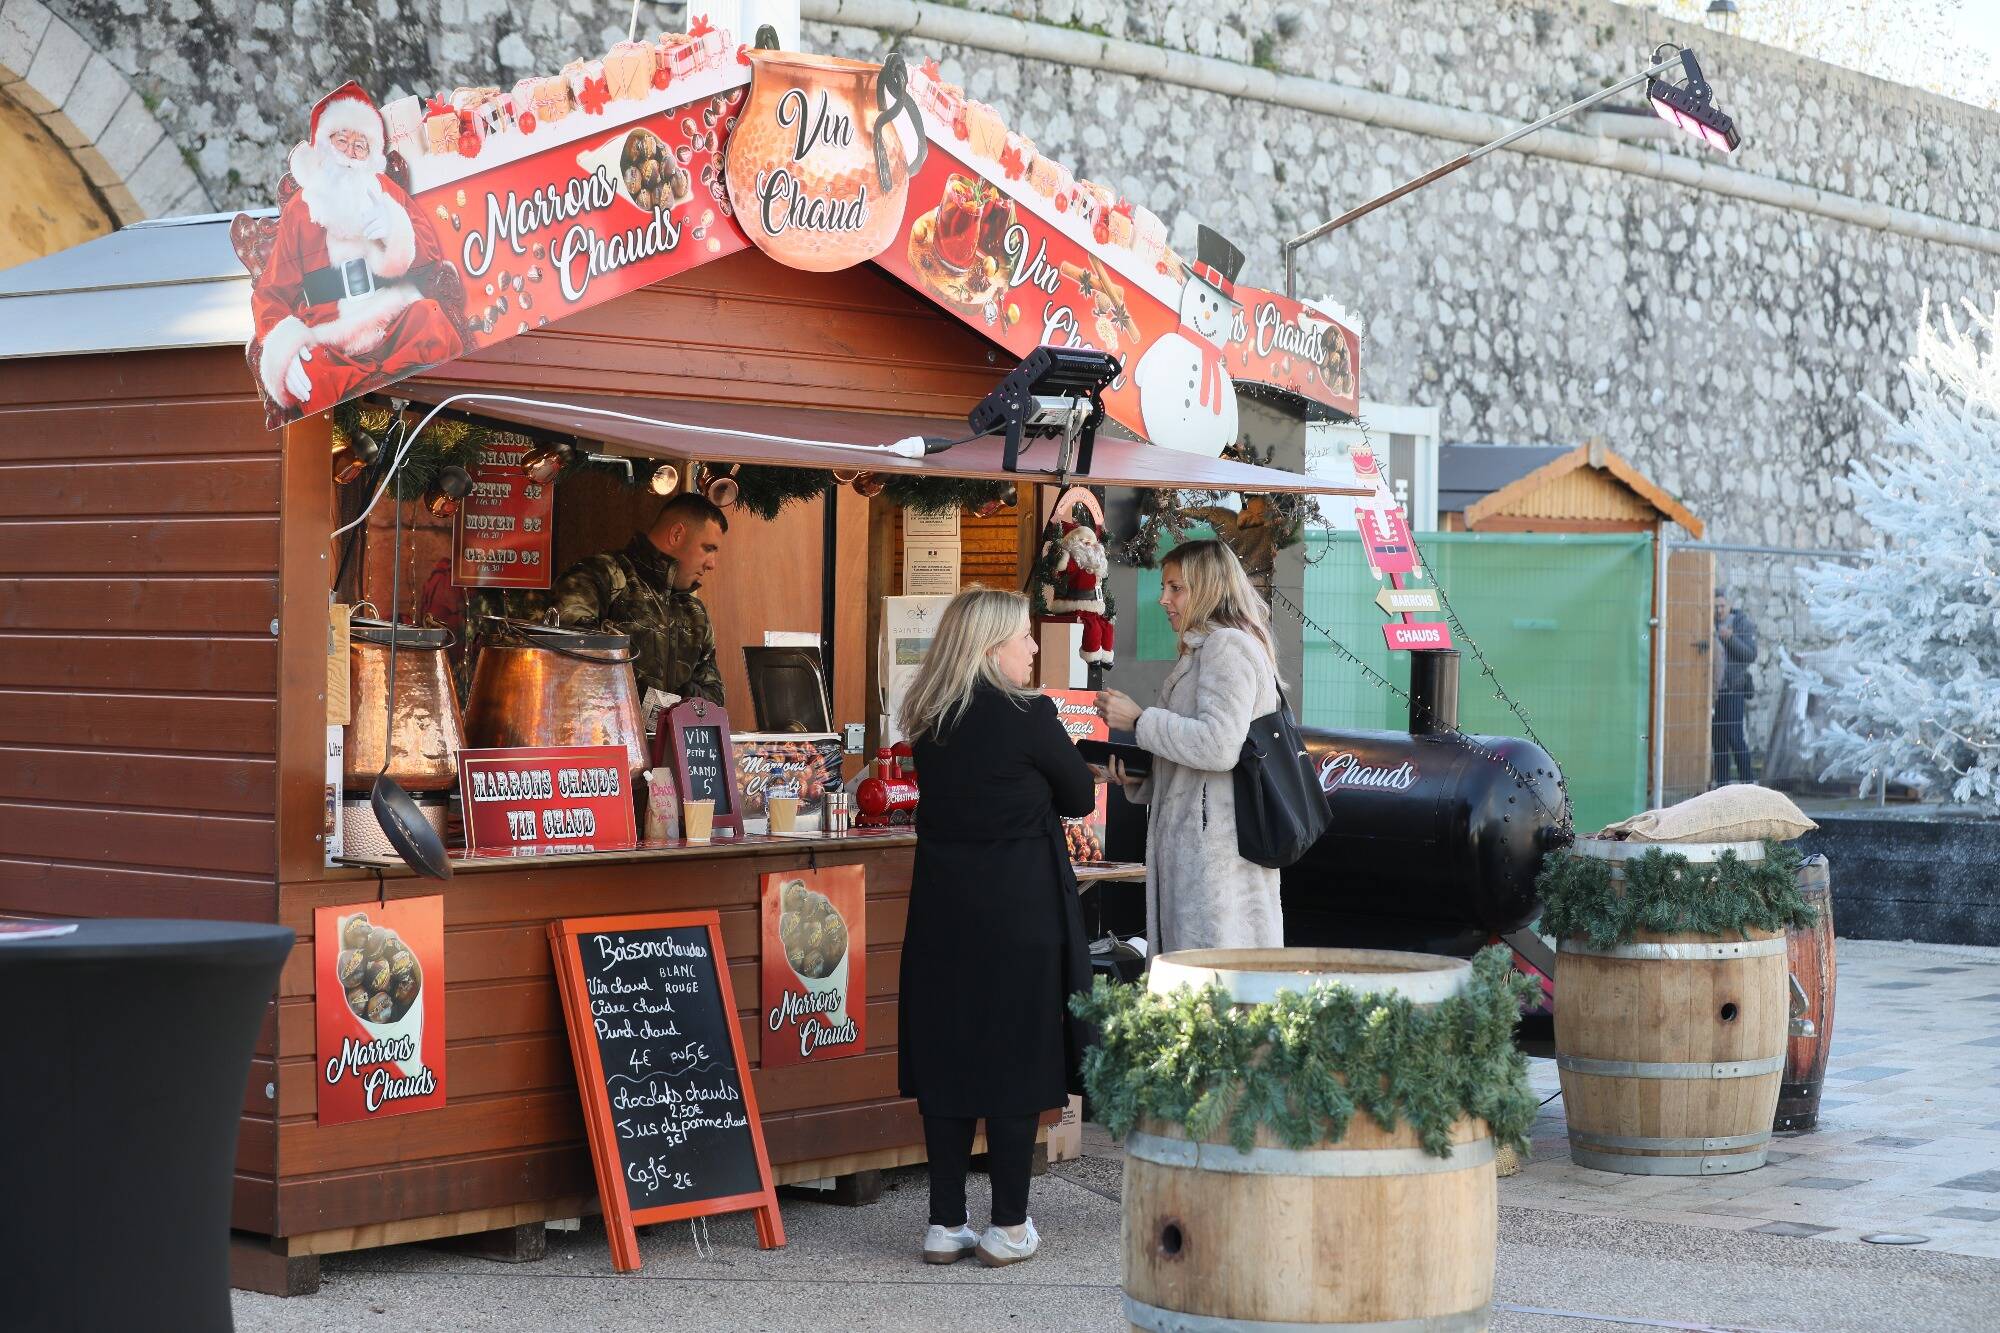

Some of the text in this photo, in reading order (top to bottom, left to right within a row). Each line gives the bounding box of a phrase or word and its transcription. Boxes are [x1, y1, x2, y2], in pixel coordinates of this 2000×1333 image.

[775, 88, 854, 163] Vin
[756, 168, 869, 237] Chaud
[463, 165, 618, 276] Marrons
[550, 206, 683, 302] Chauds
[1003, 224, 1061, 294] Vin
[1255, 301, 1328, 366] Chauds
[468, 482, 511, 498] PETIT
[465, 514, 516, 531] MOYEN
[464, 548, 518, 564] GRAND
[1389, 594, 1435, 607] MARRONS
[1396, 629, 1440, 643] CHAUDS
[685, 728, 709, 745] VIN
[688, 765, 718, 777] GRAND
[1318, 752, 1417, 792] Chauds
[472, 767, 620, 802] MARRONS CHAUDS
[505, 807, 596, 841] VIN CHAUD
[659, 964, 696, 978] BLANC
[586, 976, 699, 996] Vin chaud ROUGE
[590, 997, 675, 1016] Cidre chaud
[769, 987, 842, 1031] Marrons
[593, 1018, 682, 1041] Punch chaud
[799, 1017, 860, 1057] Chauds
[326, 1034, 414, 1084] Marrons
[629, 1048, 652, 1074] 4€
[363, 1066, 438, 1112] Chauds
[613, 1078, 739, 1110] chocolats chauds
[669, 1103, 704, 1120] 2,50€
[617, 1118, 659, 1139] Jus
[666, 1133, 684, 1148] 3€
[672, 1171, 694, 1190] 2€
